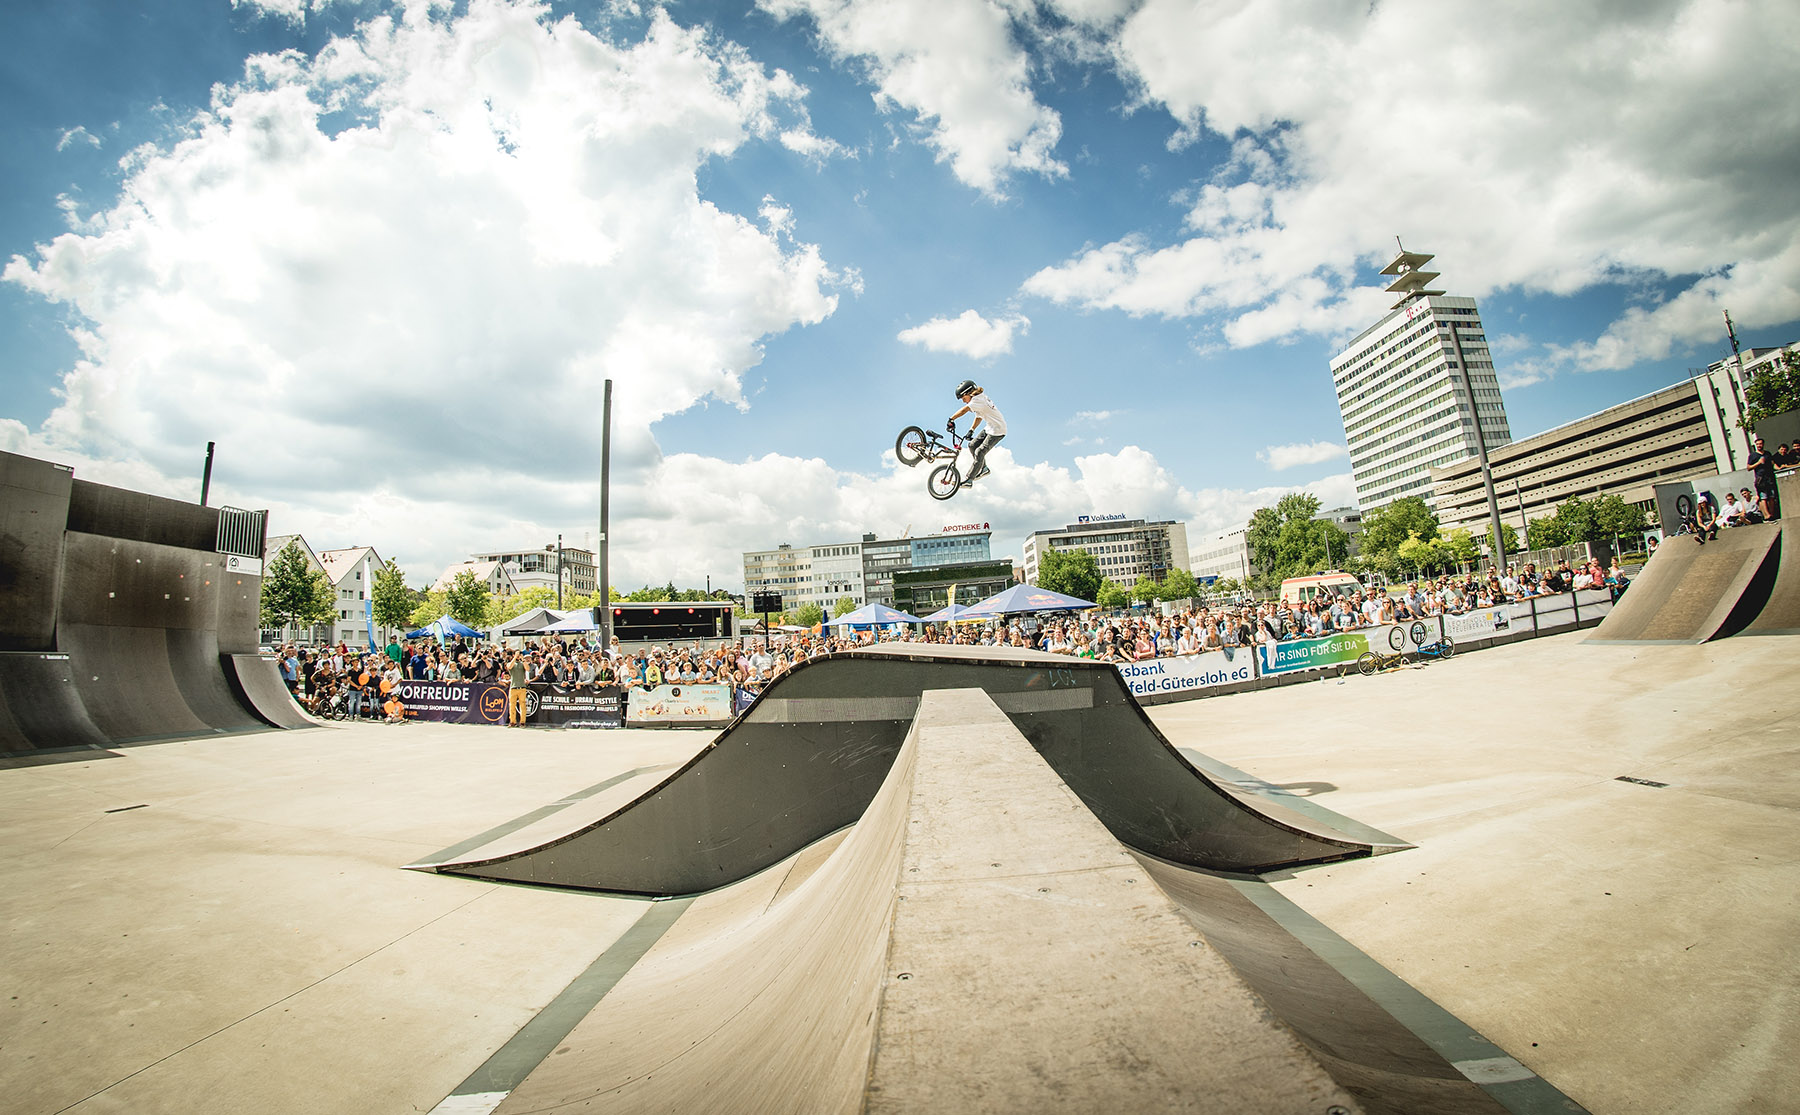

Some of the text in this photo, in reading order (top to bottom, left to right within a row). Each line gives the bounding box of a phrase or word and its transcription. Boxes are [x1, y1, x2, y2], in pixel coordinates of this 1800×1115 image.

[1091, 513, 1127, 521] Volksbank
[942, 523, 981, 532] APOTHEKE
[1287, 647, 1309, 660] SIND
[1331, 641, 1343, 653] SIE
[1344, 640, 1358, 651] DA
[1116, 661, 1165, 678] ksbank
[1129, 667, 1248, 694] feld-Gütersloh eG
[485, 696, 504, 709] LOOM
[575, 696, 593, 704] URBAN
